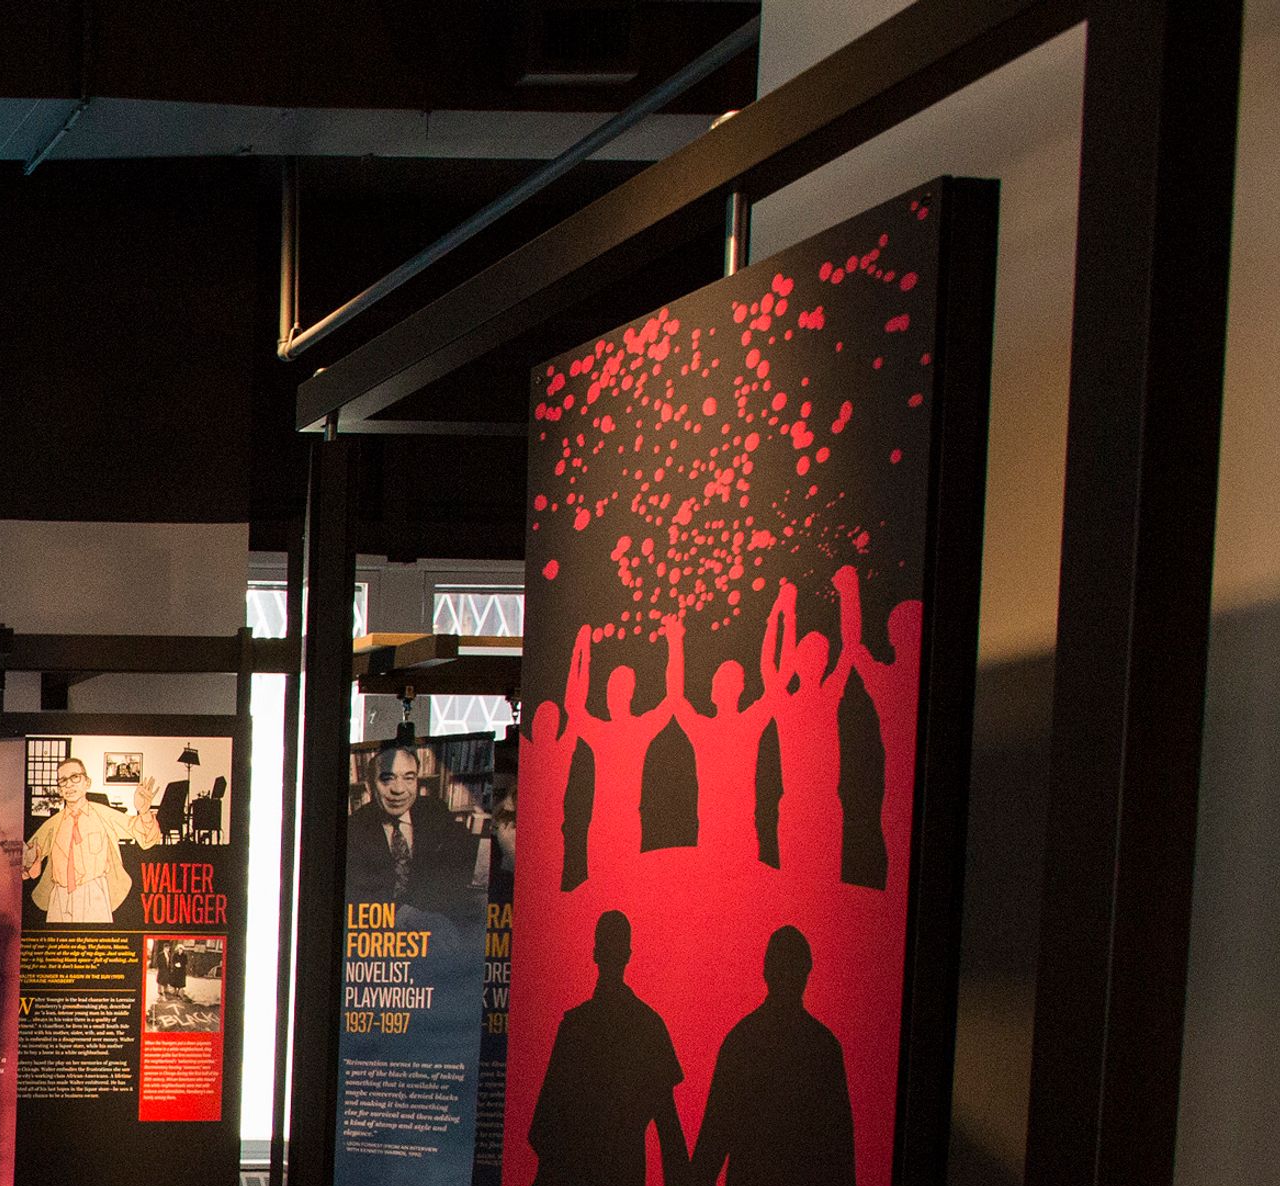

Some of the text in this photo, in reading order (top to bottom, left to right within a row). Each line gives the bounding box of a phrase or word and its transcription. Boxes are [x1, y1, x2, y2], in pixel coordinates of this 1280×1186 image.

[141, 862, 214, 893] WALTER
[141, 892, 228, 925] YOUNGER
[347, 903, 396, 930] LEON
[346, 932, 432, 958] FORREST
[345, 962, 415, 985] NOVELIST,
[344, 987, 435, 1009] PLAYWRIGHT
[344, 1012, 411, 1034] 1937-1997
